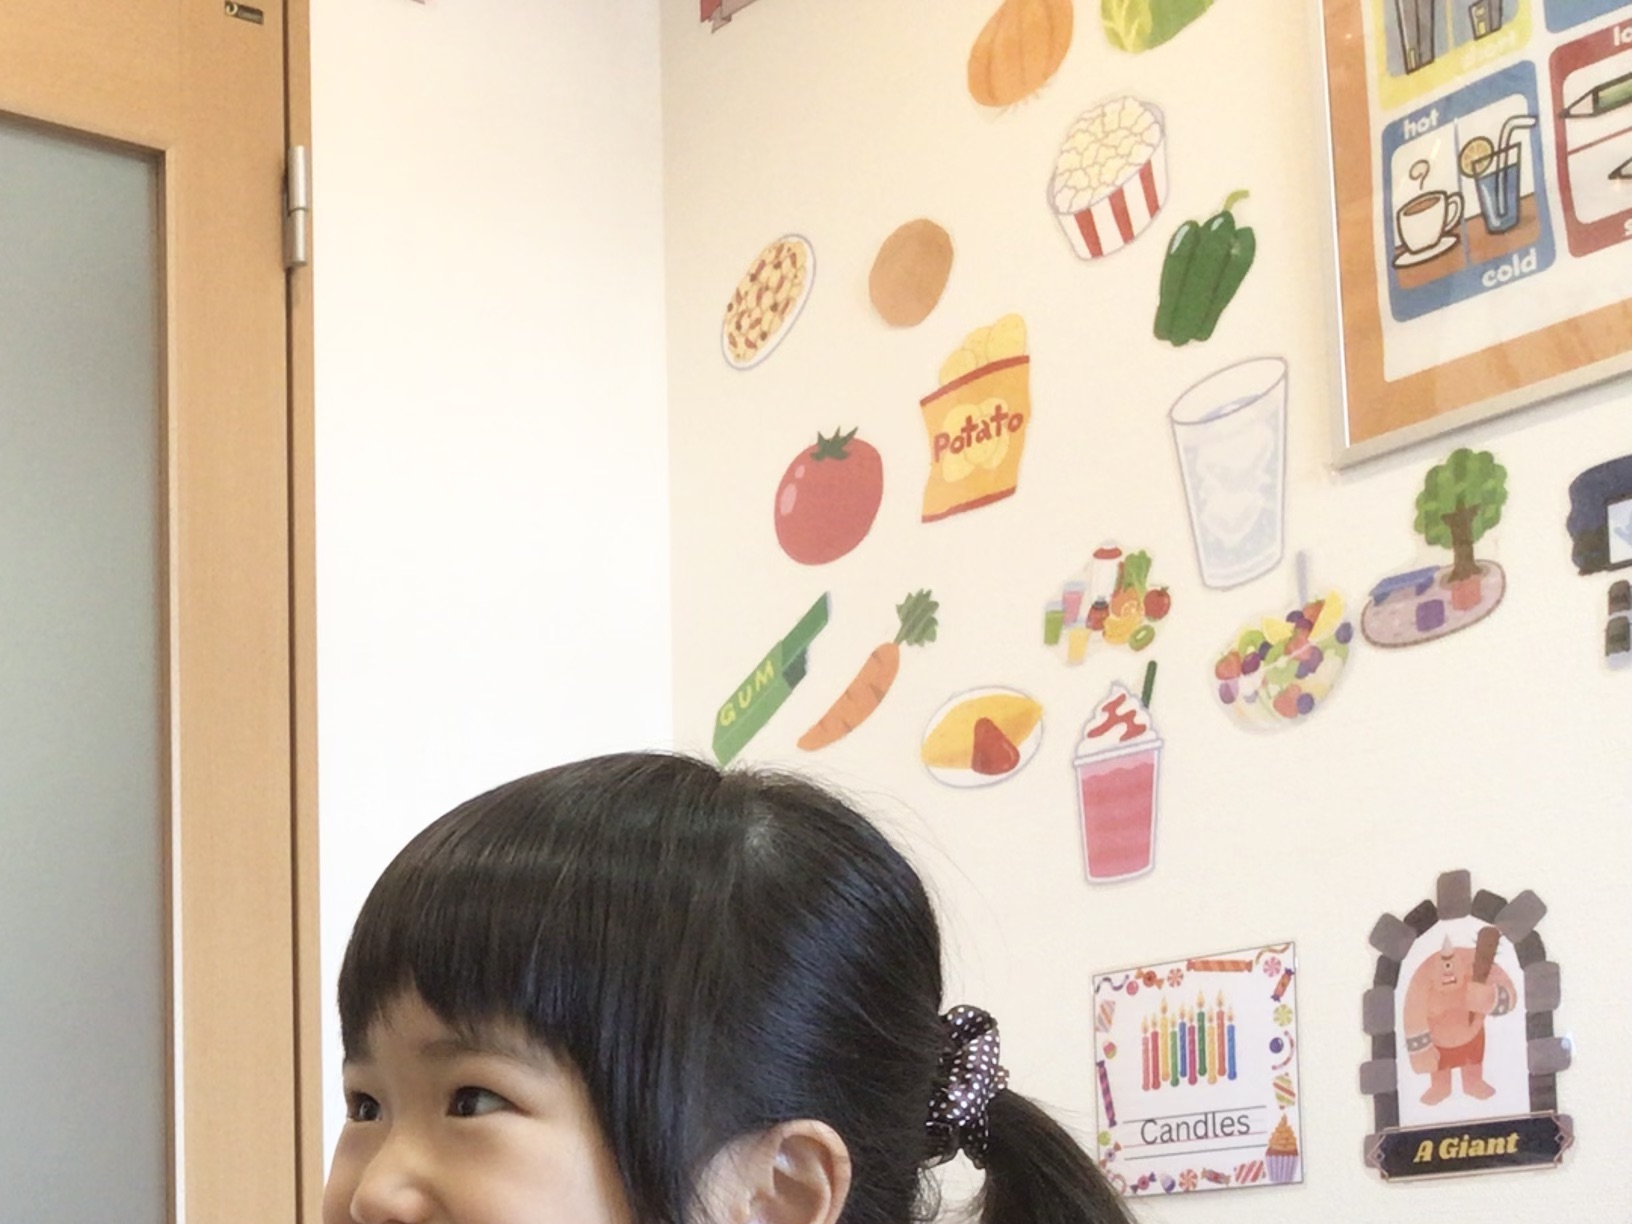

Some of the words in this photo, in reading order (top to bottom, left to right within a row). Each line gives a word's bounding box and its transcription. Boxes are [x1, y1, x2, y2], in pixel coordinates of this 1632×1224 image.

[1403, 108, 1440, 140] hot
[1482, 247, 1538, 288] cold
[933, 403, 1024, 463] Potato
[720, 660, 774, 727] GUM
[1140, 1111, 1251, 1145] Candles
[1412, 1139, 1434, 1163] A
[1438, 1132, 1521, 1160] Giant
